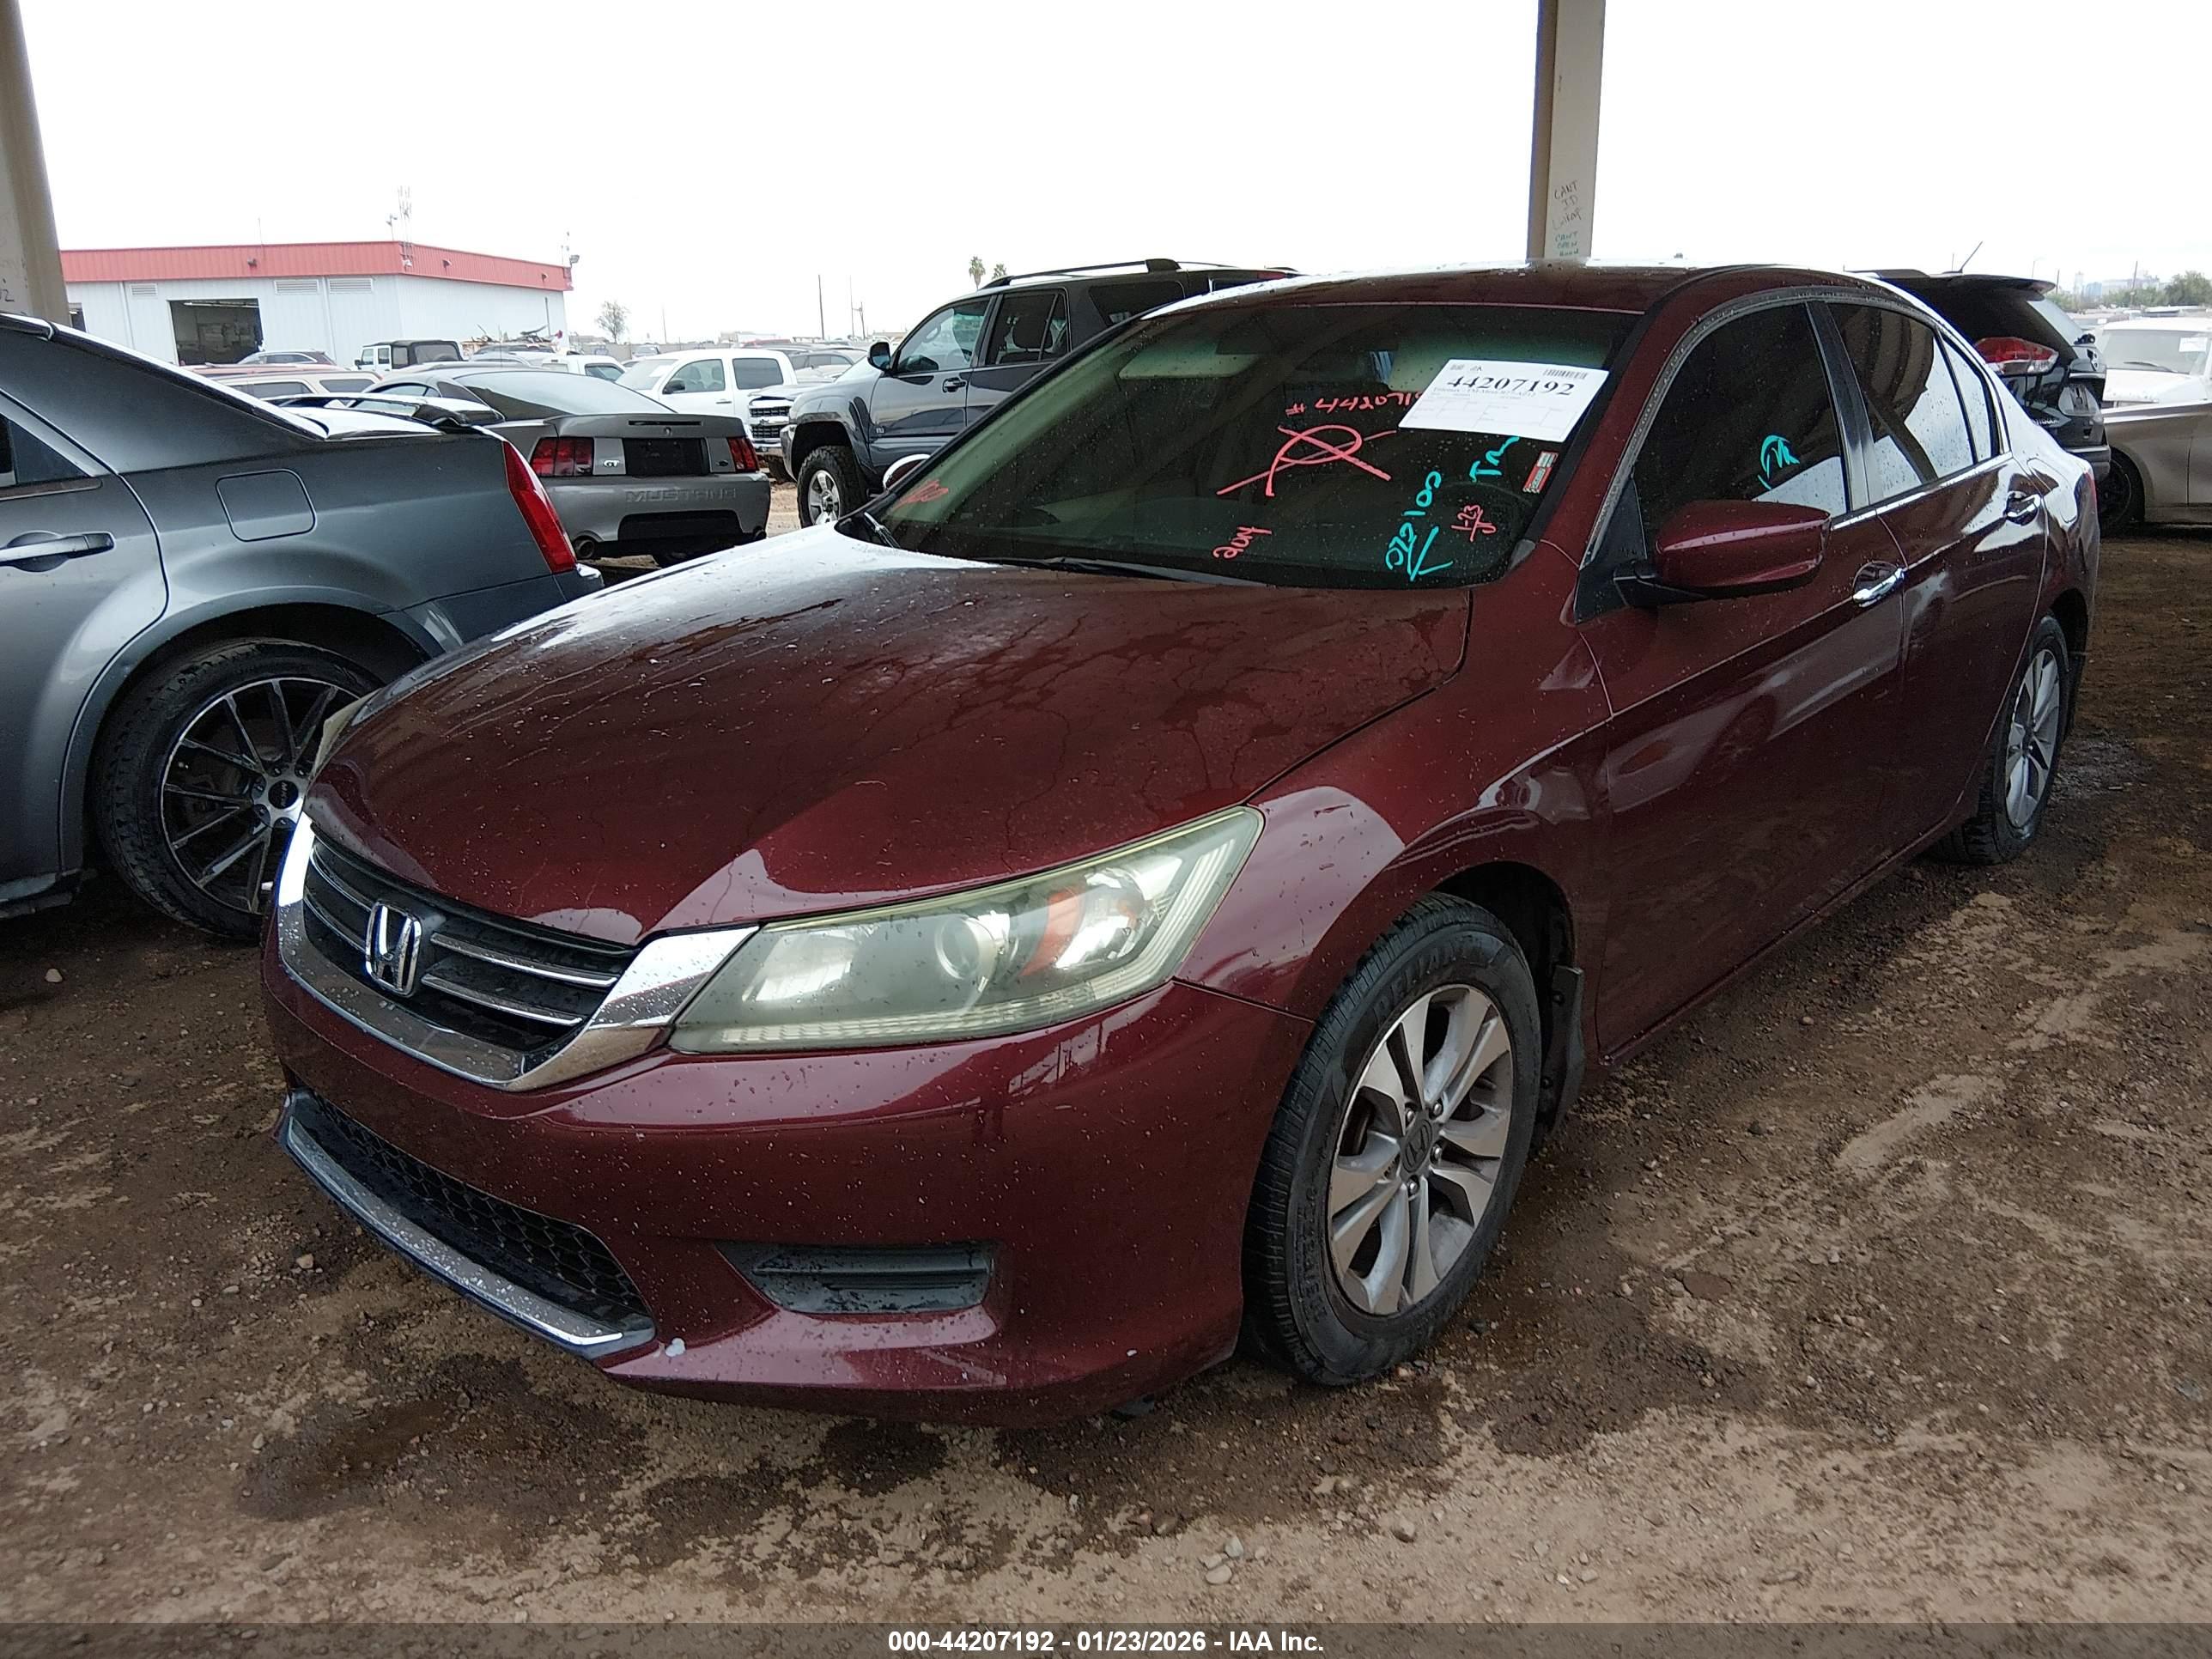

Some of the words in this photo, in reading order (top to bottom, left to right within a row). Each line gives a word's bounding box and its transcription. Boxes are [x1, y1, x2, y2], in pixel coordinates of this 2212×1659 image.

[1446, 375, 1575, 396] 44207192
[1285, 402, 1306, 417] #
[603, 459, 620, 468] GT
[624, 487, 737, 503] MUSTANG
